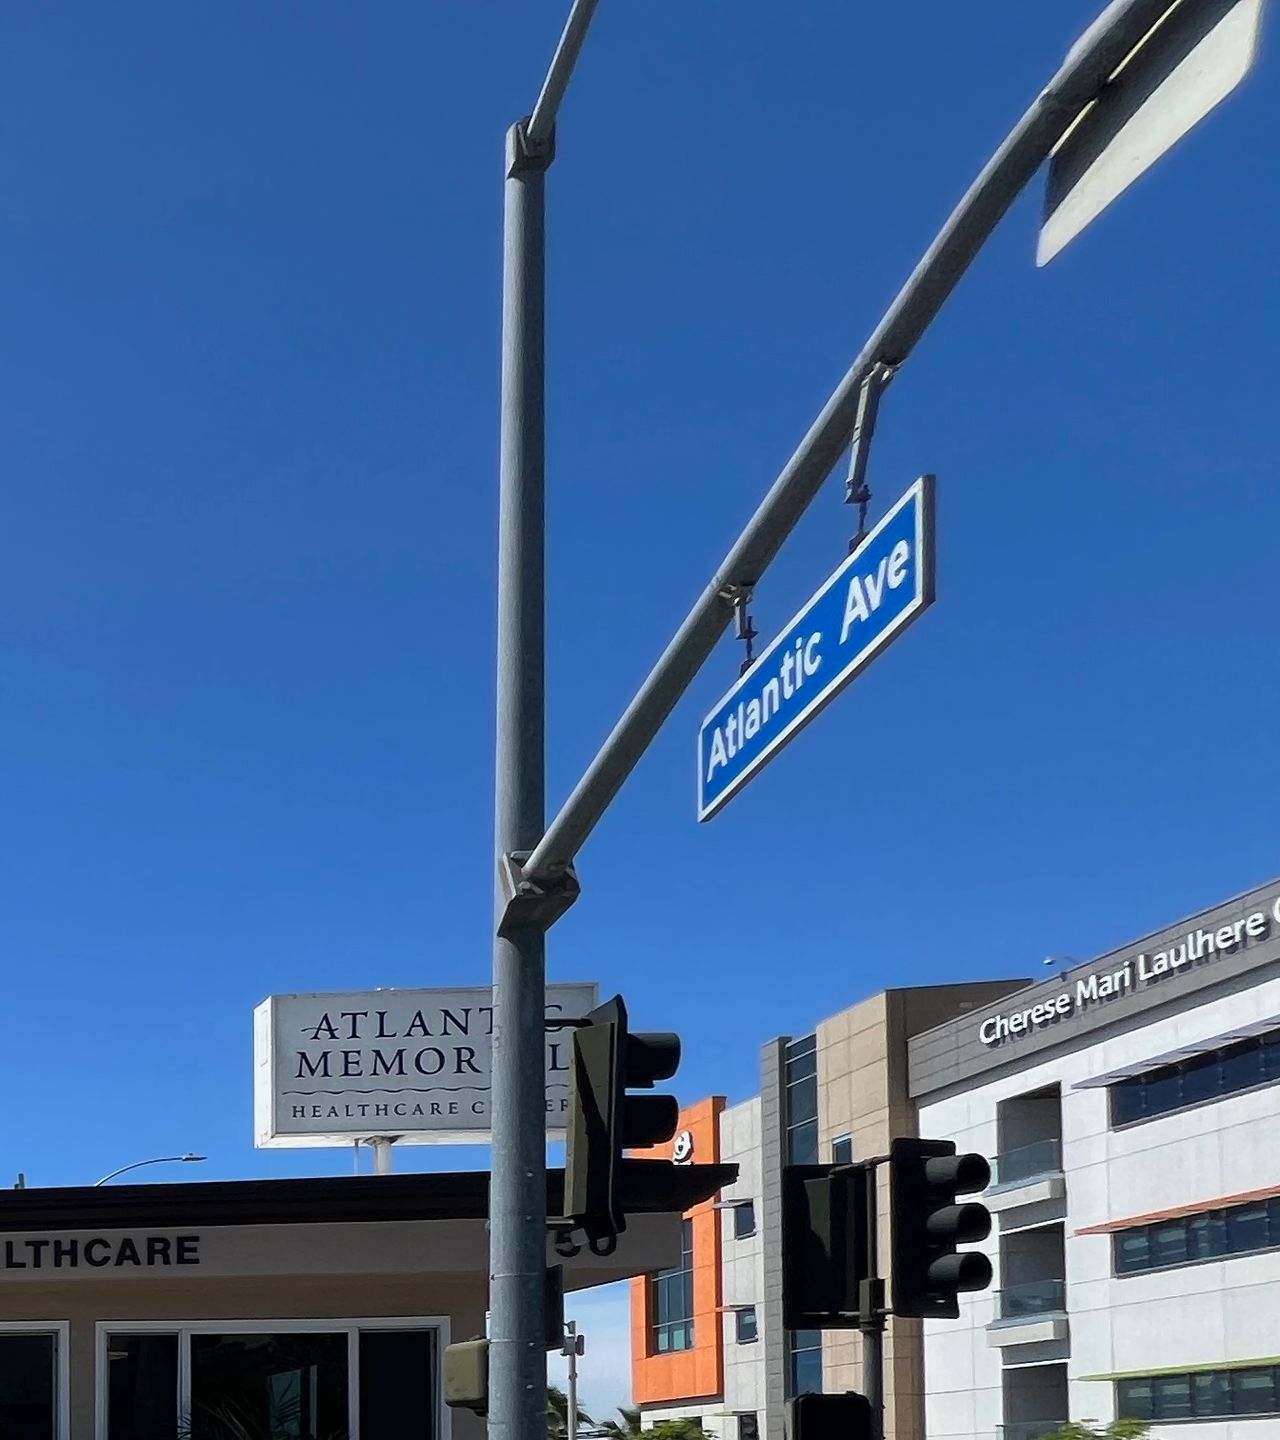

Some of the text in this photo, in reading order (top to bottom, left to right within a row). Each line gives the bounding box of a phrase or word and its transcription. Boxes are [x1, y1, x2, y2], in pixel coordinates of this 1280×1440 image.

[706, 539, 910, 783] Atlantic Ave
[978, 911, 1266, 1045] Cherese Mari Laulhere
[301, 1003, 563, 1041] ATLANTC
[295, 1043, 570, 1079] MEMORL
[292, 1101, 459, 1119] HEALTHCARE
